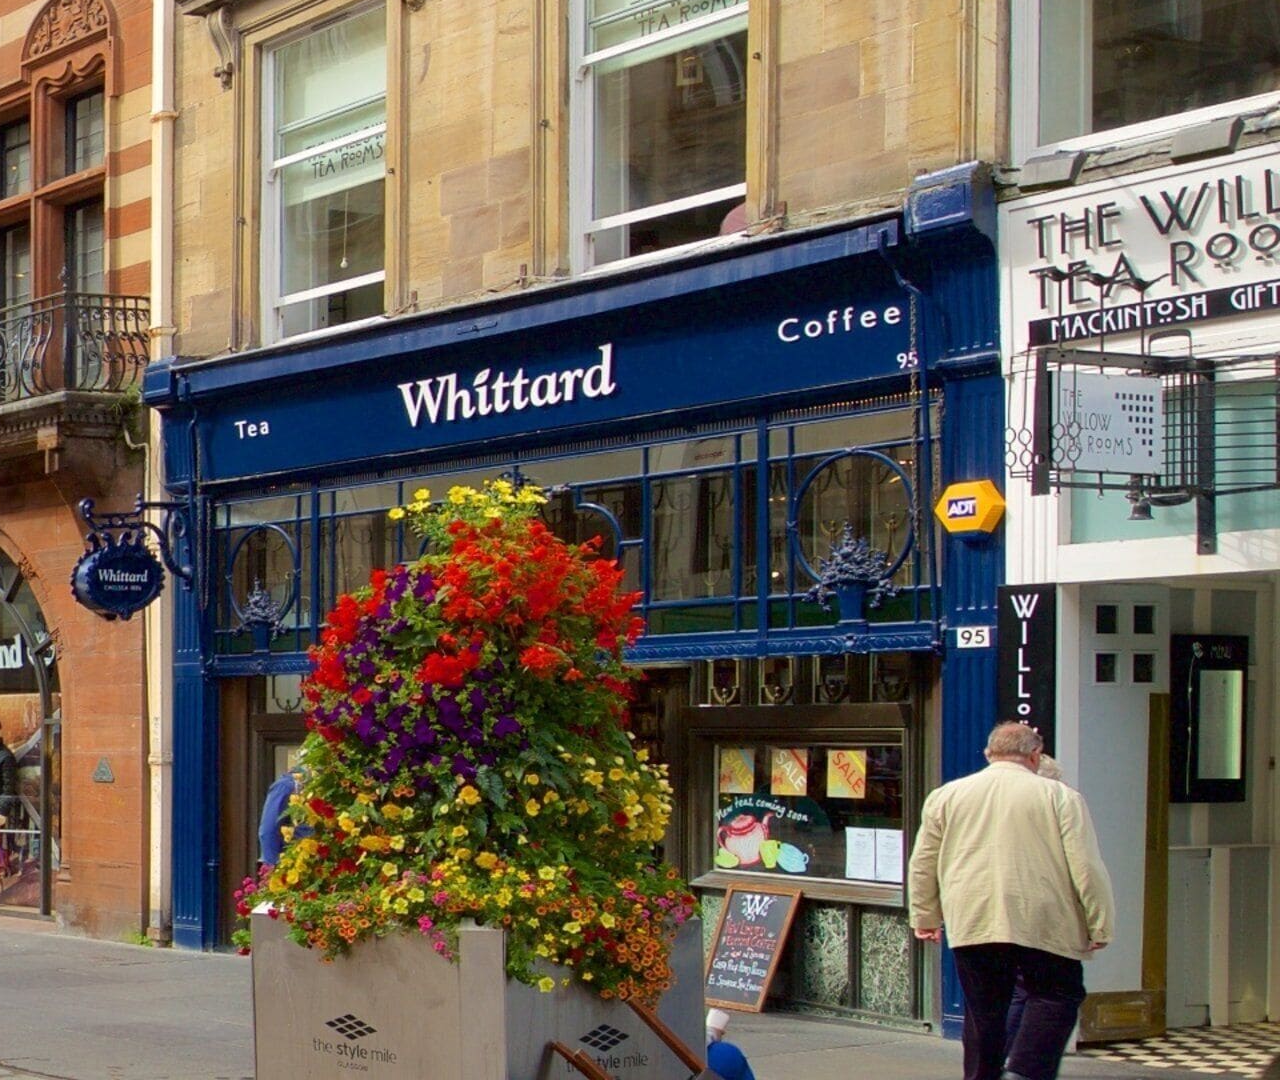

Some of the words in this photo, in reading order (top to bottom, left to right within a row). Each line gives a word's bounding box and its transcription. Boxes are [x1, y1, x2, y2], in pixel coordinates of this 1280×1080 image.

[312, 158, 335, 179] TEA
[341, 141, 383, 170] ROOMS
[1027, 201, 1122, 259] THE
[1029, 252, 1140, 310] TEA
[778, 306, 901, 342] Coffee
[1051, 294, 1207, 341] MACKINTOSH
[896, 352, 918, 368] 95
[398, 343, 616, 428] Whittard
[234, 419, 269, 439] Tea
[1087, 435, 1133, 456] ROOMS
[948, 499, 976, 516] ADT
[98, 569, 148, 582] Whittard
[961, 629, 985, 645] 95
[1010, 593, 1039, 732] WILLO
[724, 751, 752, 790] SALE
[776, 751, 806, 791] SALE
[833, 752, 864, 794] SALE
[716, 804, 733, 821] New
[756, 800, 786, 818] coming
[786, 811, 809, 822] soon
[313, 1038, 333, 1054] the
[336, 1042, 367, 1060] style
[370, 1047, 397, 1064] mile
[597, 1055, 621, 1071] tyle
[623, 1052, 648, 1067] mile
